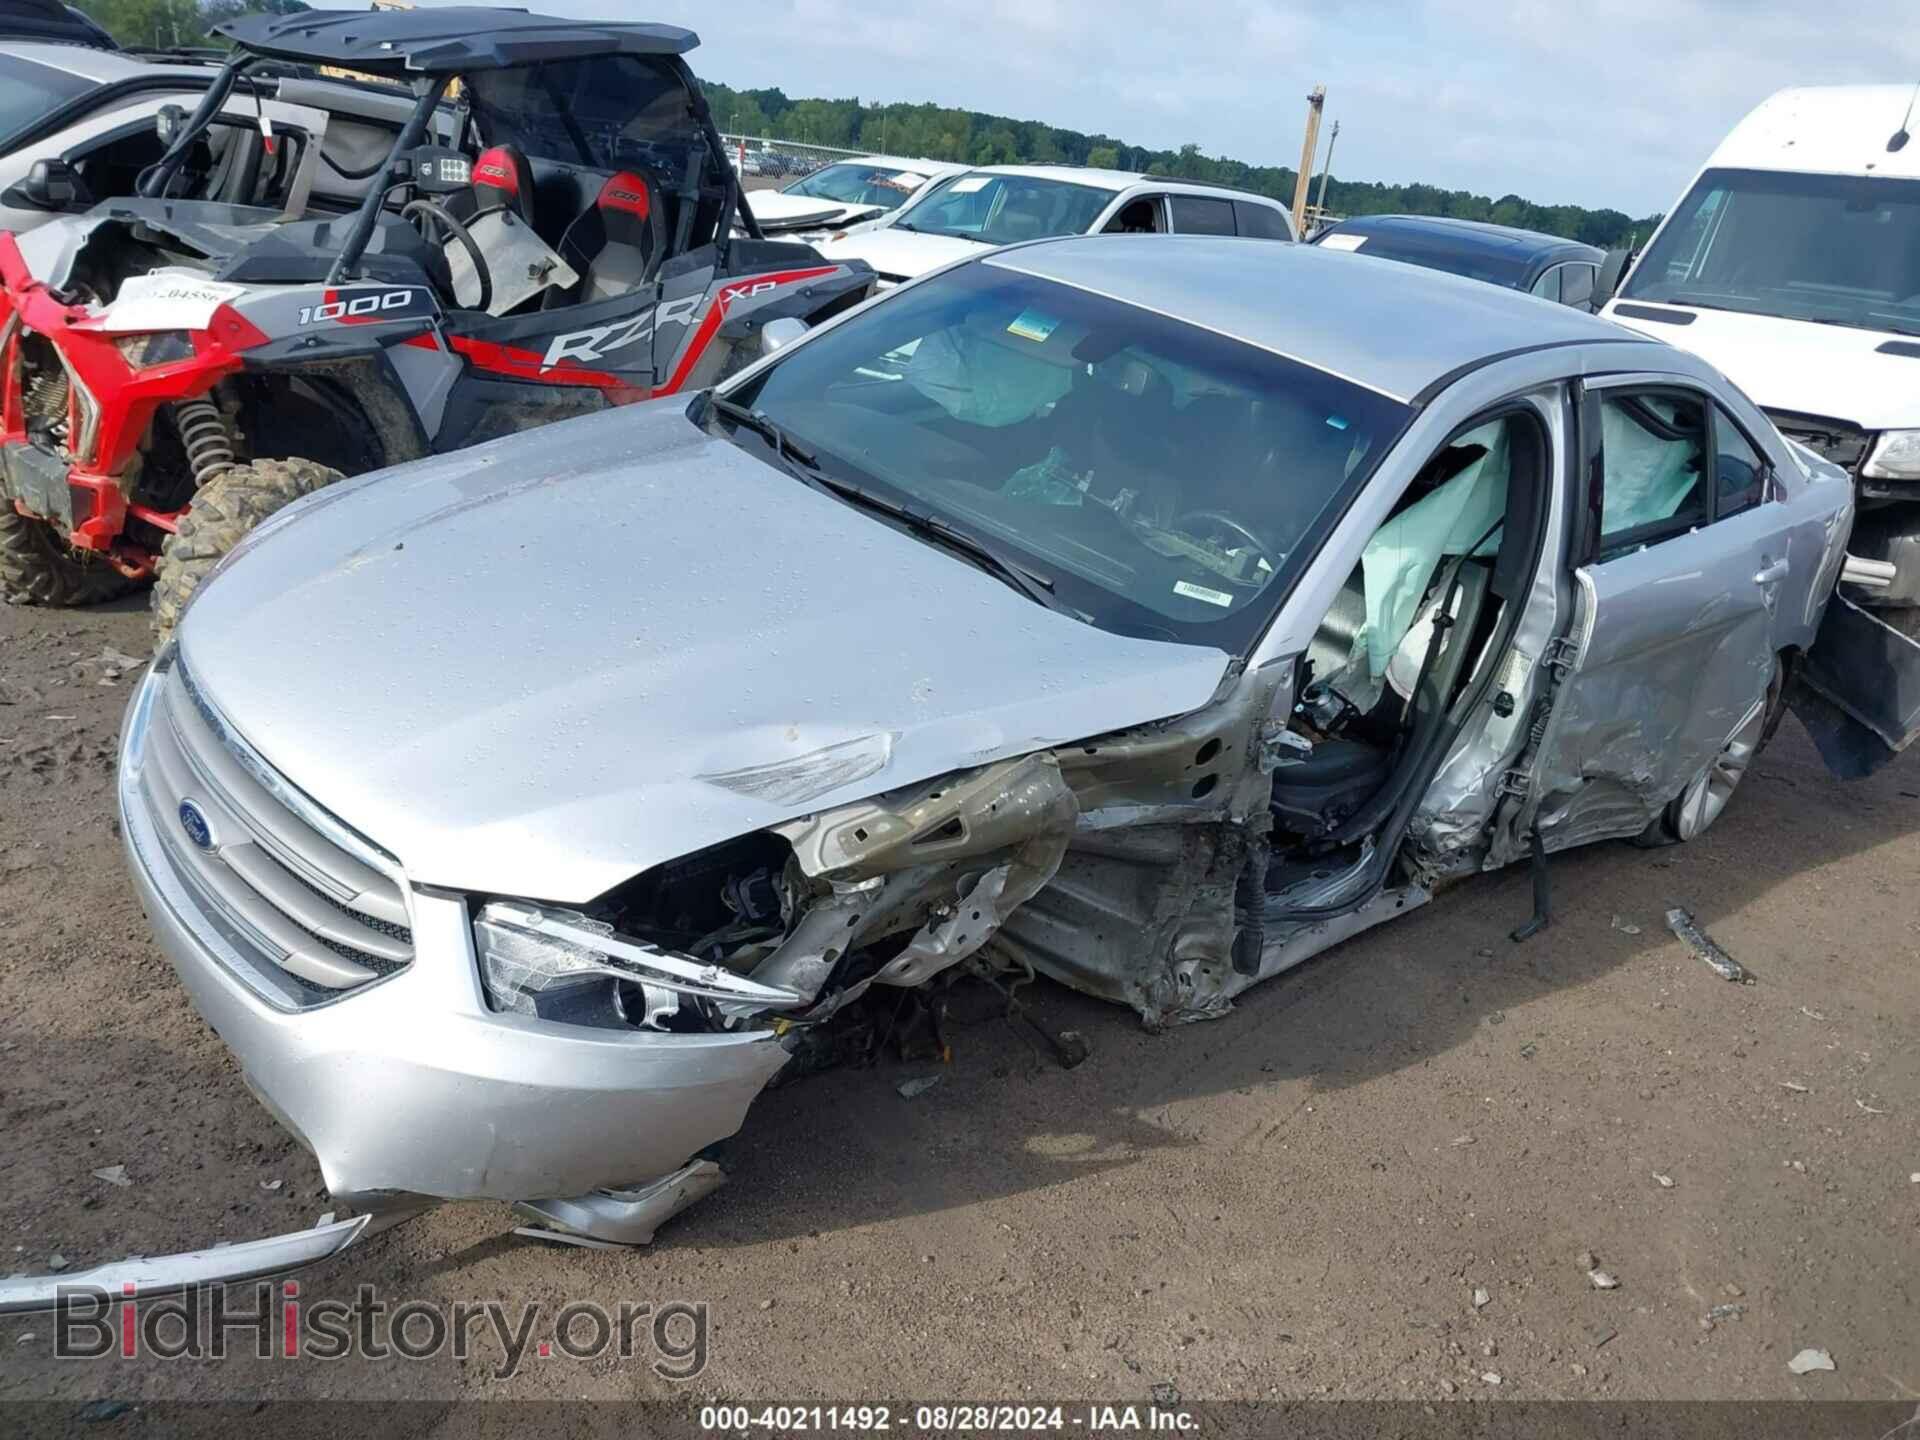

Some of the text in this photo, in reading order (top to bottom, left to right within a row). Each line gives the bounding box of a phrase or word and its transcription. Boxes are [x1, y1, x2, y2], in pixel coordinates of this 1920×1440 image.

[298, 290, 412, 325] 1000
[723, 281, 776, 303] XP
[183, 809, 206, 842] Ford
